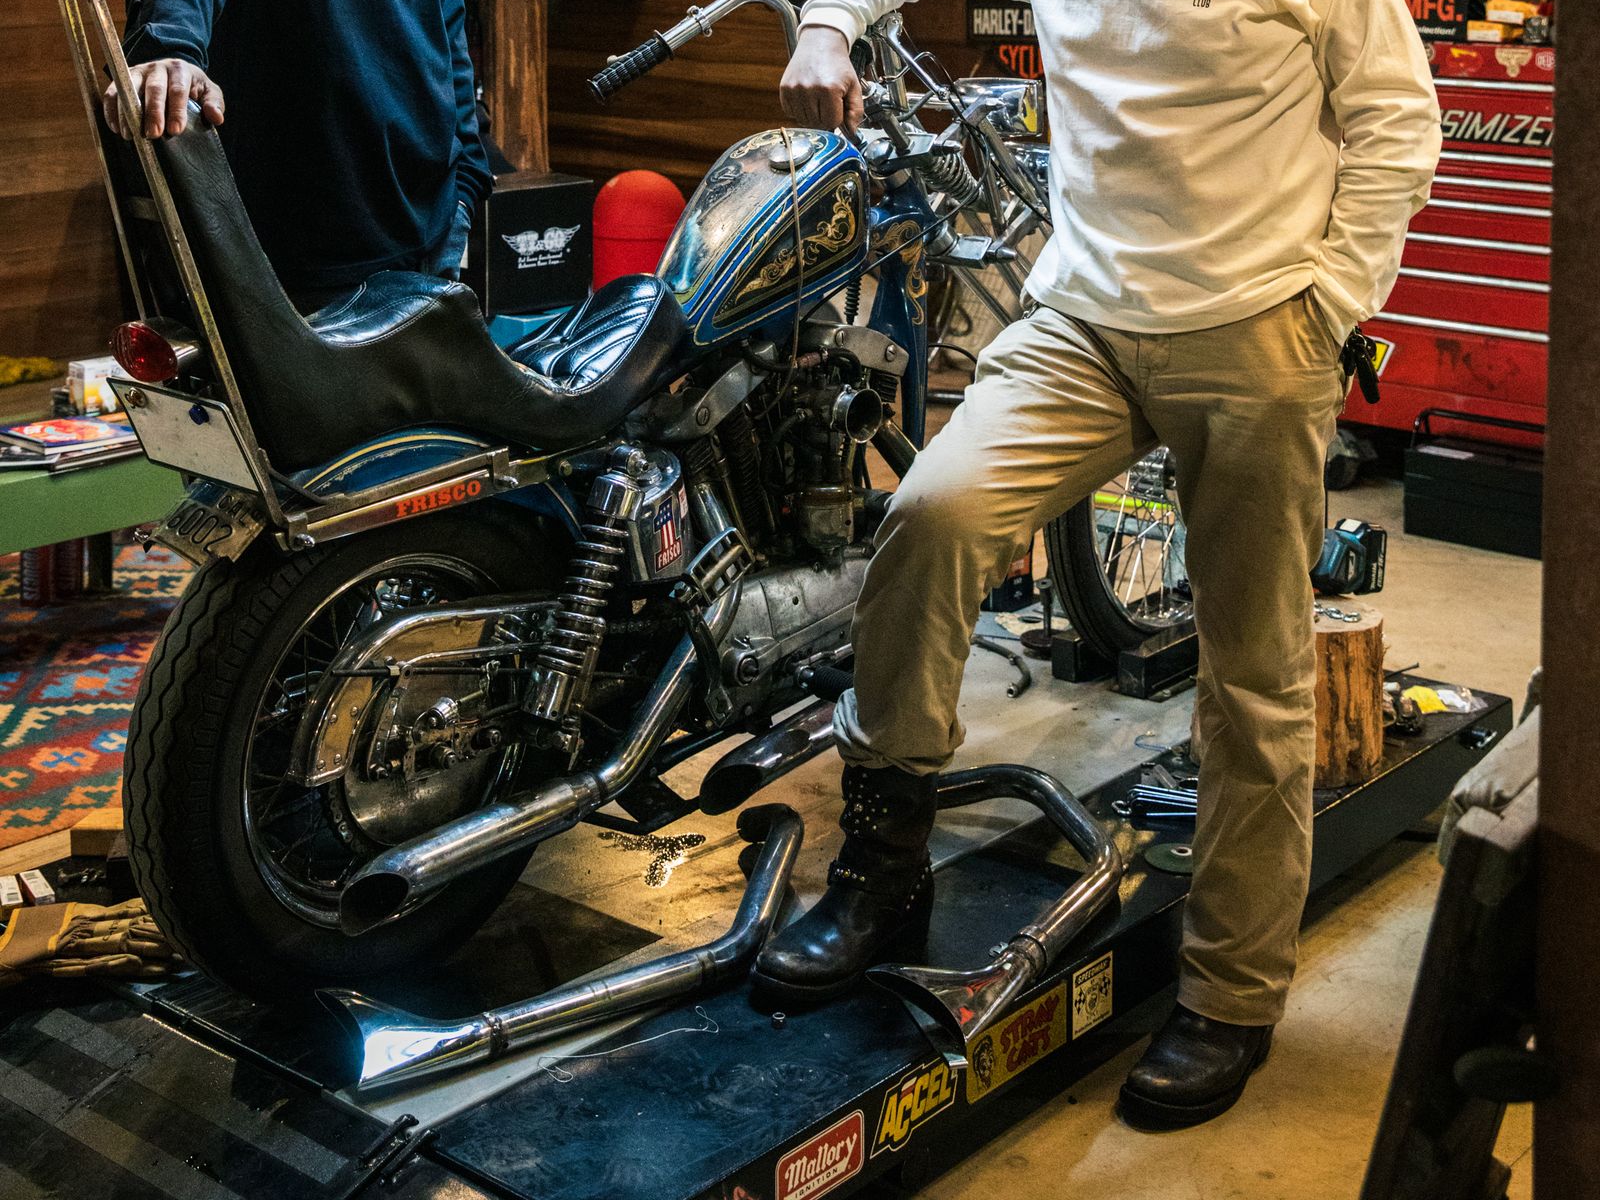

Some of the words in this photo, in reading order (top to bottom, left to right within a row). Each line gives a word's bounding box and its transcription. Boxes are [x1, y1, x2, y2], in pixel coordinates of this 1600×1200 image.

[1440, 109, 1554, 146] SIMIZE
[395, 480, 481, 518] FRISCO
[658, 542, 681, 569] FRISCO
[1000, 994, 1060, 1054] STRAY
[1006, 1025, 1051, 1073] CATS
[879, 1062, 952, 1145] ACCEL
[785, 1132, 858, 1193] Mallory
[795, 1168, 838, 1199] IGNITION
